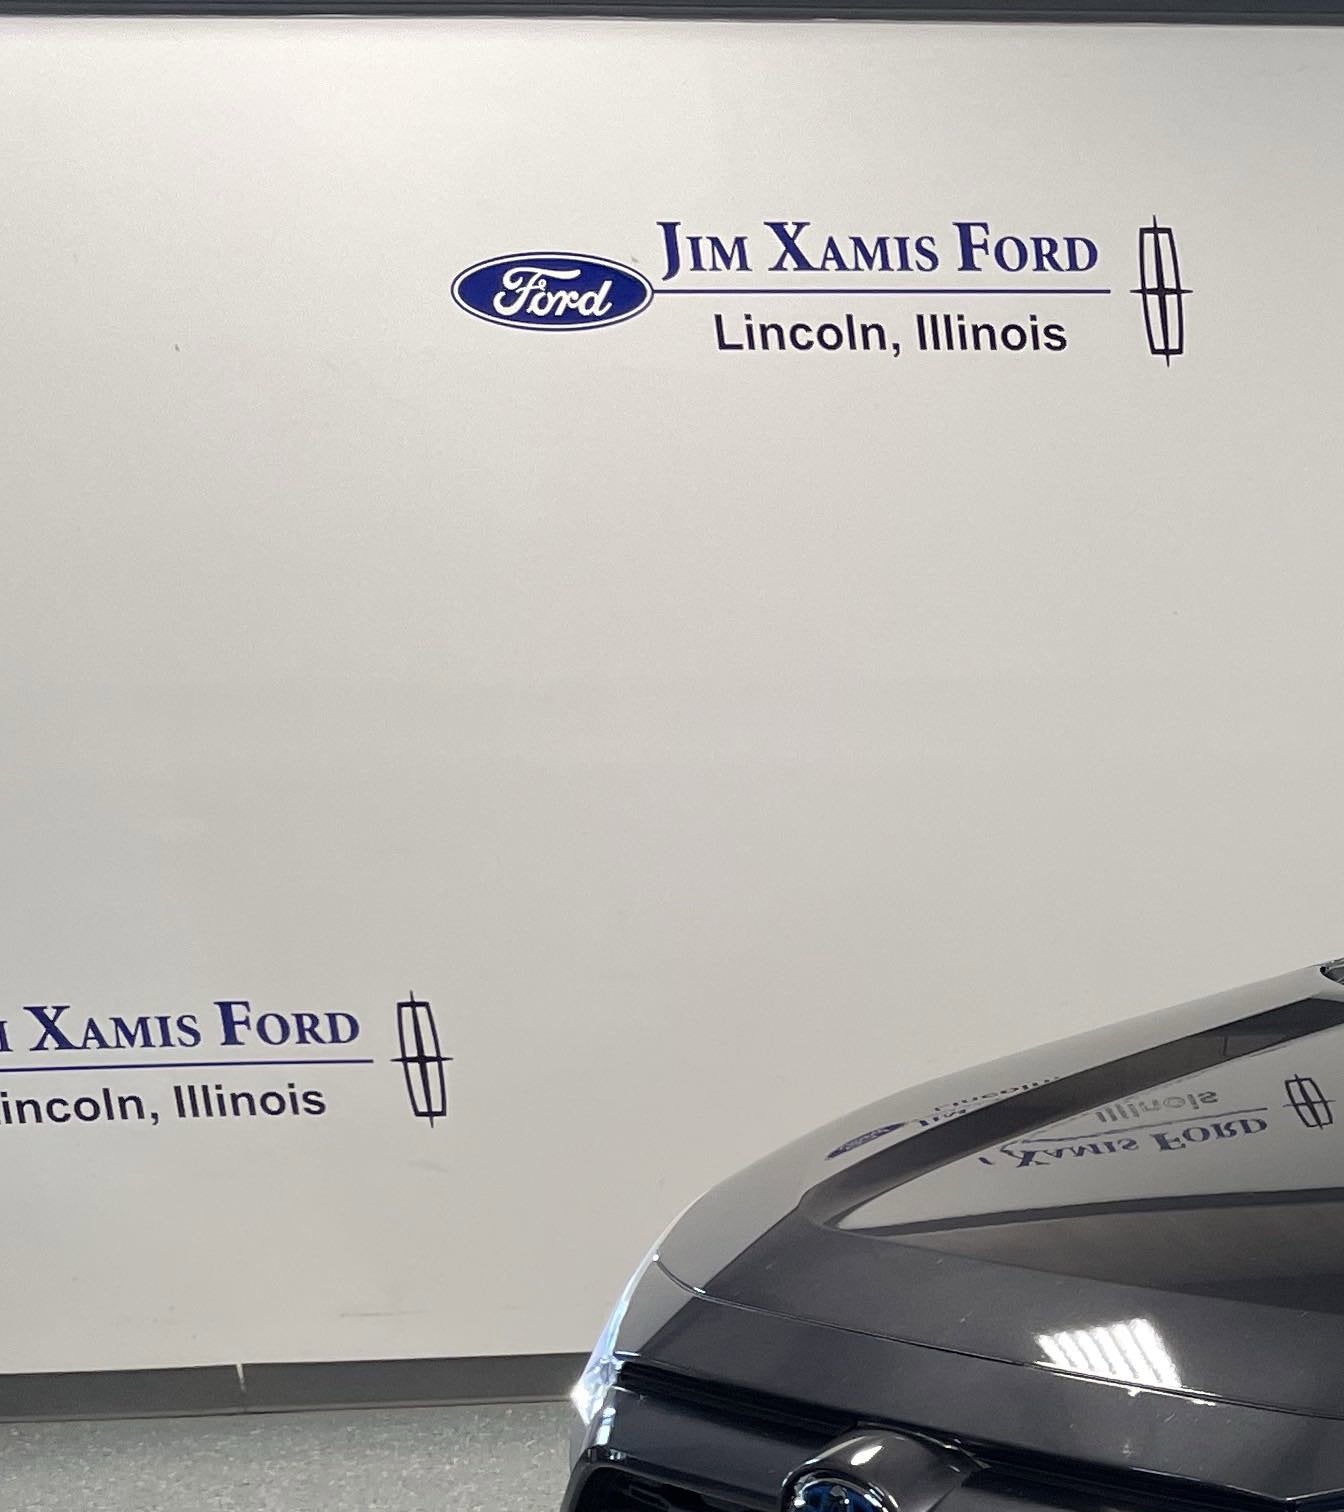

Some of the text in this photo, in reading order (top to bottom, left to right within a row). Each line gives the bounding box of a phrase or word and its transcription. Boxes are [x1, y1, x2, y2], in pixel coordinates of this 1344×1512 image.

[656, 222, 1097, 281] JIM XAMIS FORD
[494, 266, 612, 318] Ford
[715, 314, 1066, 357] Lincoln, Illinois
[23, 1006, 201, 1051] XAMIS
[214, 1001, 359, 1045] FORD
[0, 1083, 325, 1125] incoln, Illinois
